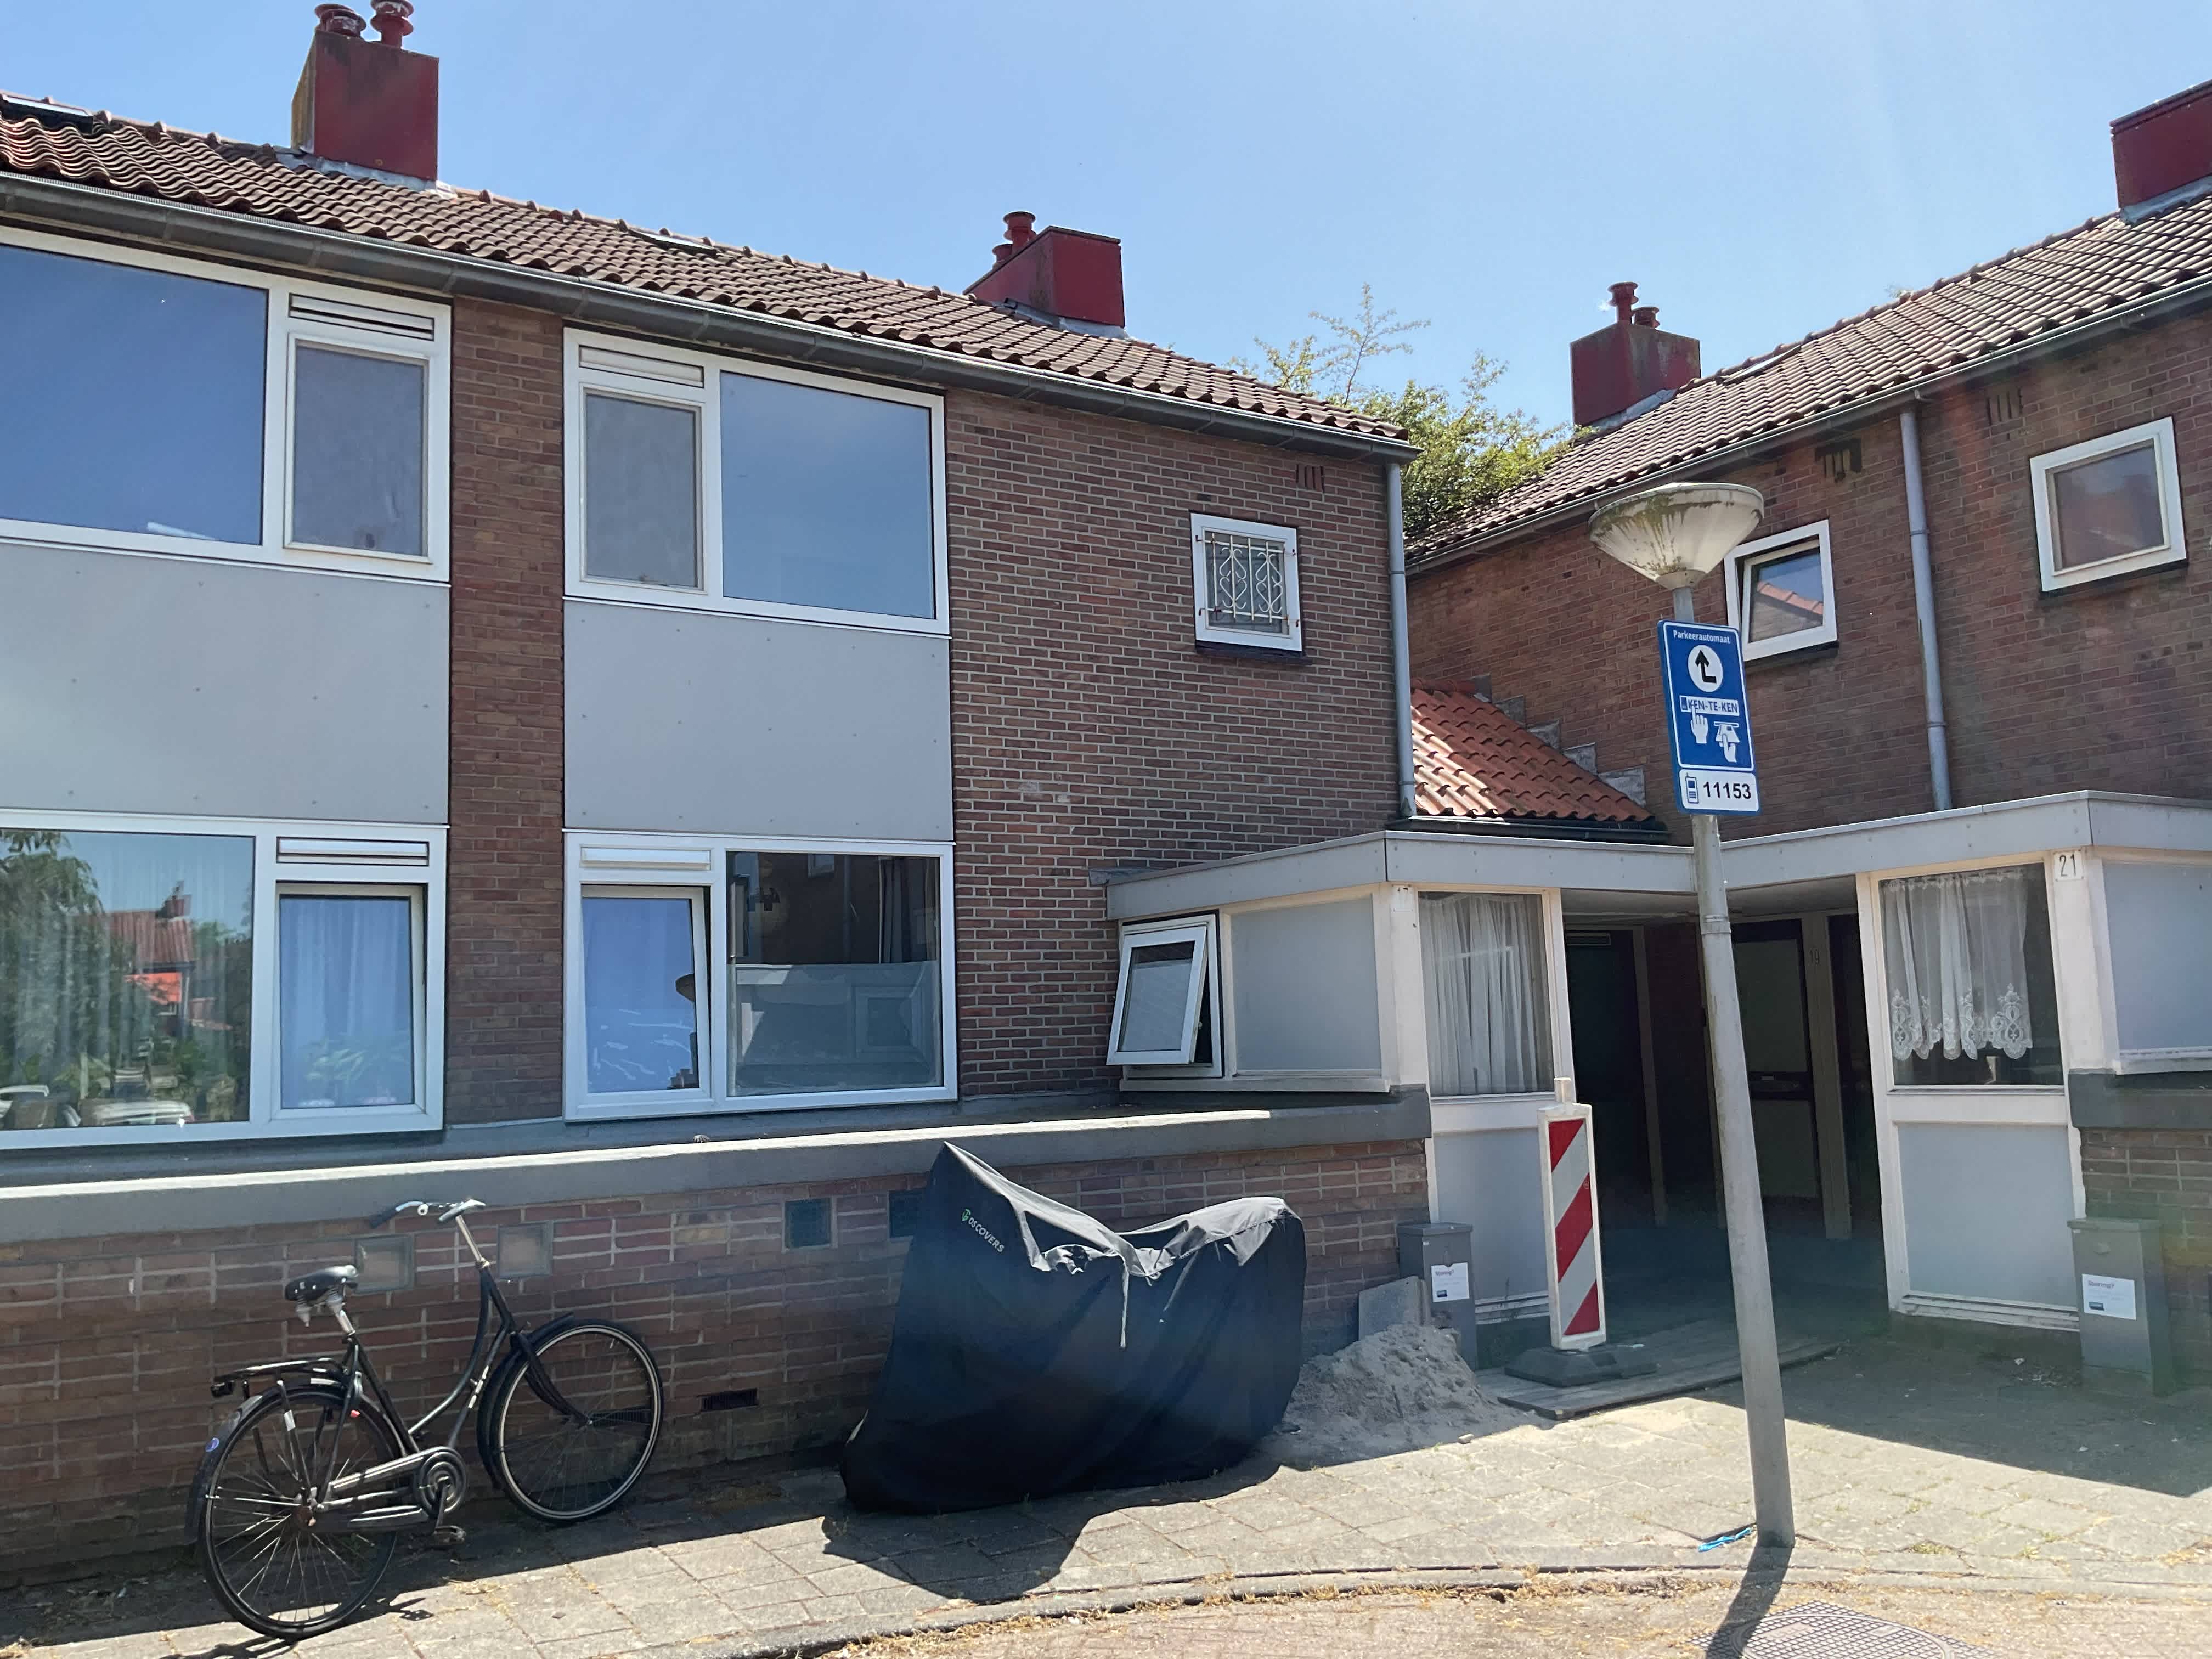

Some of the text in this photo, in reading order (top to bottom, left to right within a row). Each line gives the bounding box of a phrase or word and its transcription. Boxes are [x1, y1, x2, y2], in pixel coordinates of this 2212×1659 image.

[1673, 630, 1731, 644] Parkeerautomaat
[1703, 781, 1751, 799] 11153
[2059, 853, 2076, 877] 21
